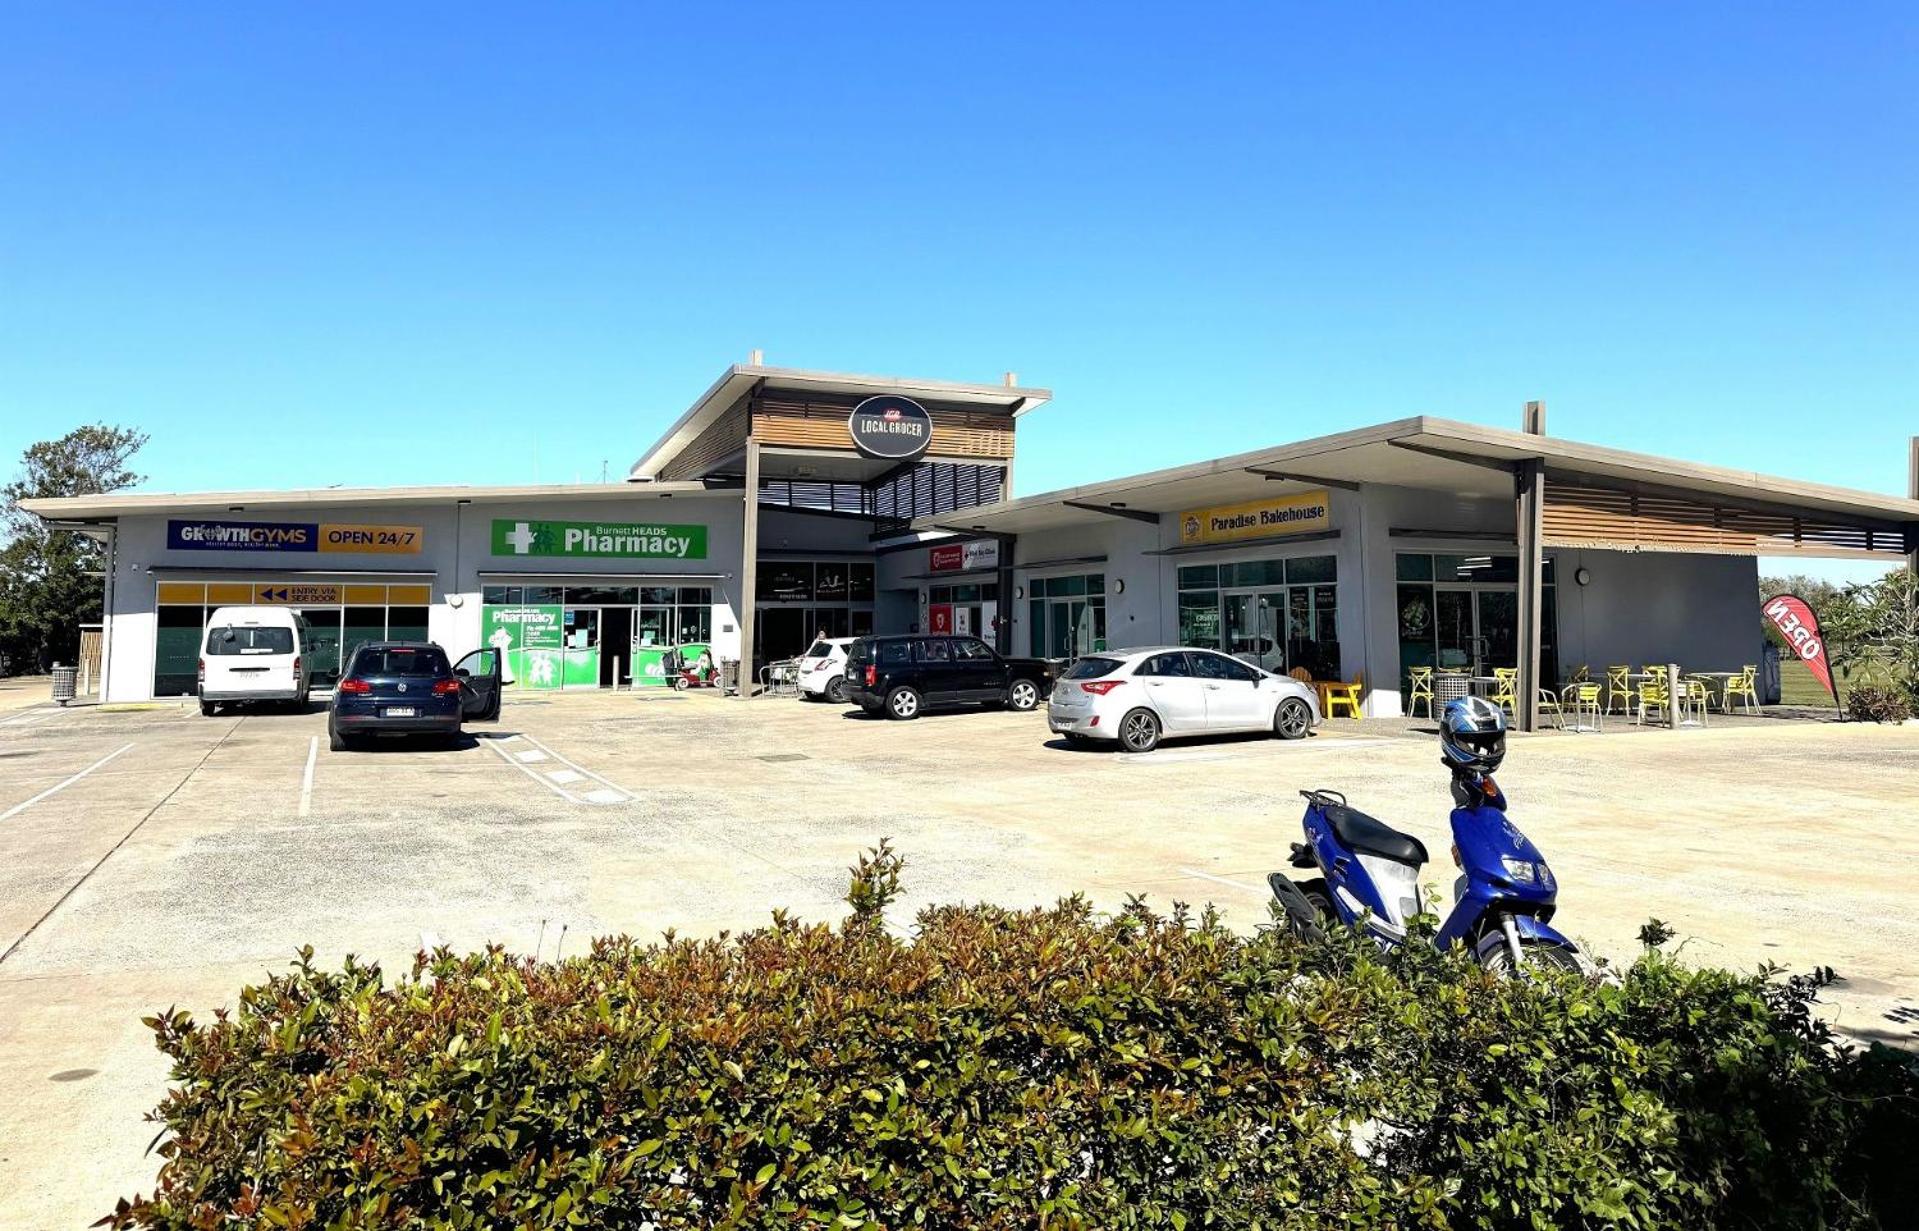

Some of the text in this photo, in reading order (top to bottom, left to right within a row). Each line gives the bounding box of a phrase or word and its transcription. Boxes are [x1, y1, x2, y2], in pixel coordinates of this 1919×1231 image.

[861, 419, 922, 438] LOCAL GROCER
[1210, 506, 1326, 531] Paradise Bakehouse
[328, 530, 416, 546] OPEN 24/7
[596, 525, 667, 537] Burnett HEADS
[565, 528, 690, 558] Pharmacy
[291, 586, 336, 595] ENTRY VIA
[492, 610, 556, 625] Pharmacy
